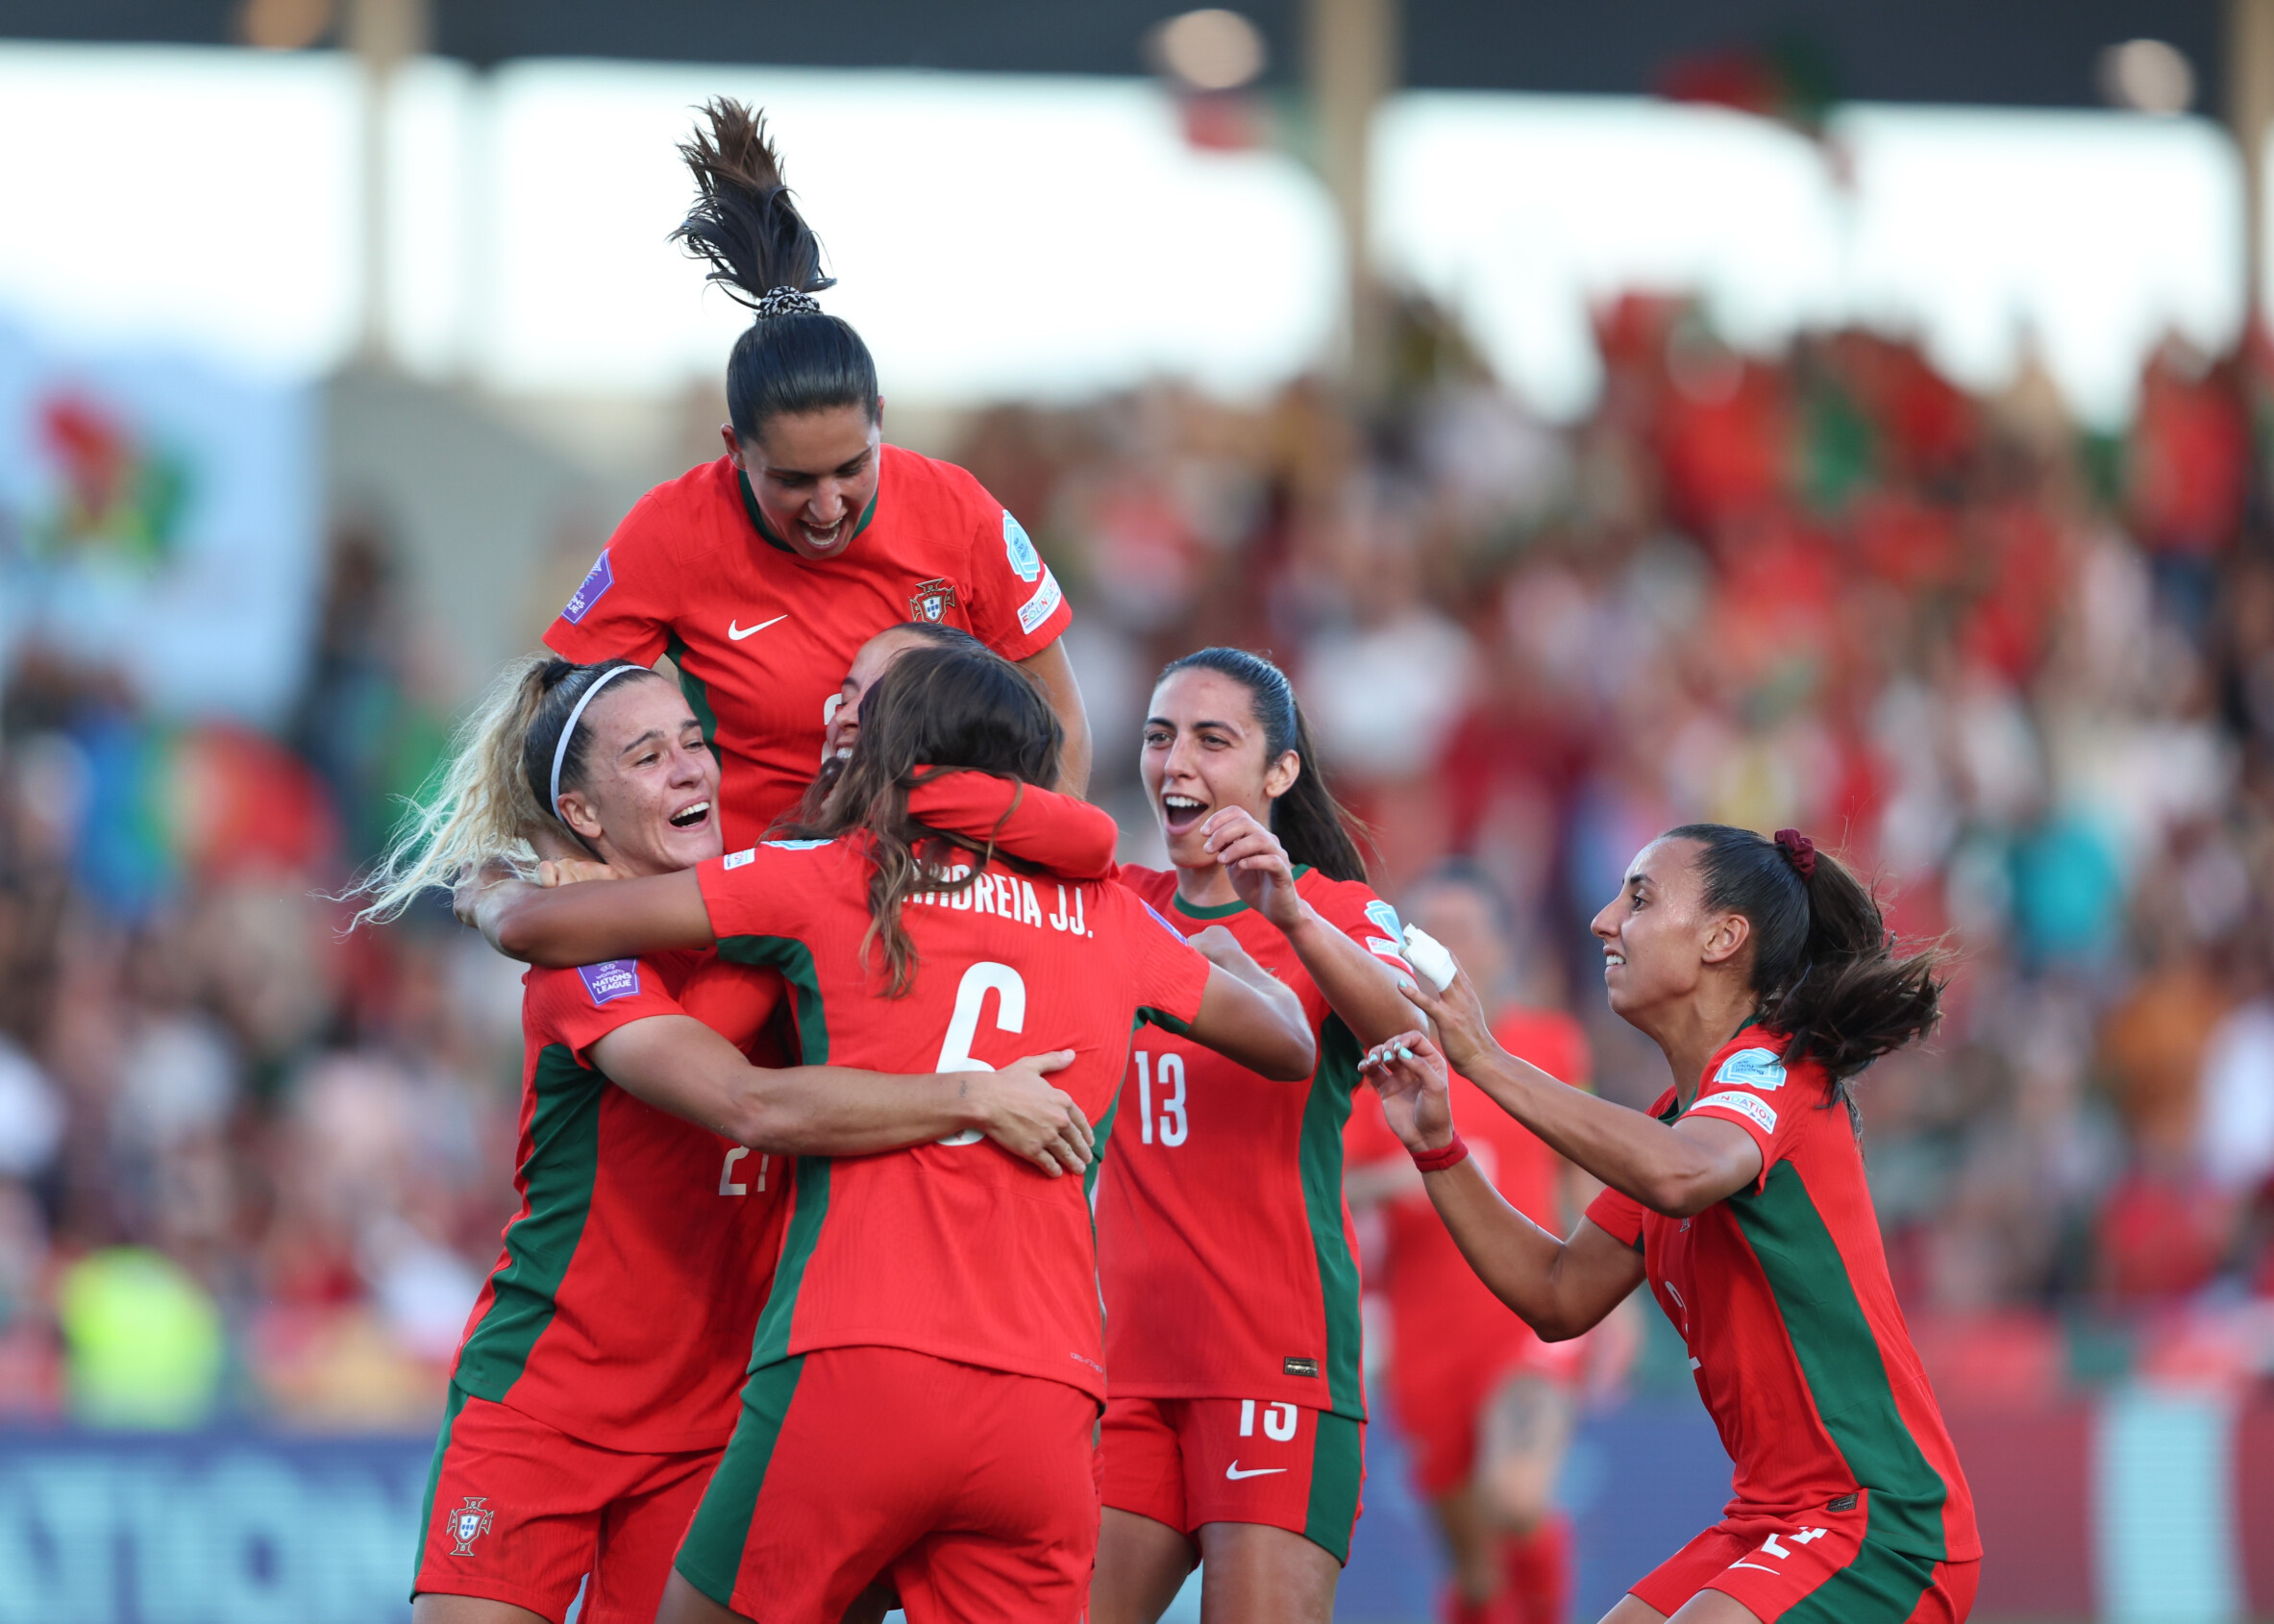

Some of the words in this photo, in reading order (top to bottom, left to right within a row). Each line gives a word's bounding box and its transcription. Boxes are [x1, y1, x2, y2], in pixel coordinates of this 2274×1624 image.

[1050, 884, 1094, 939] JJ.
[592, 972, 632, 989] NATIONS
[596, 979, 632, 995] LEAGUE
[935, 961, 1026, 1146] 6
[1134, 1050, 1189, 1147] 13
